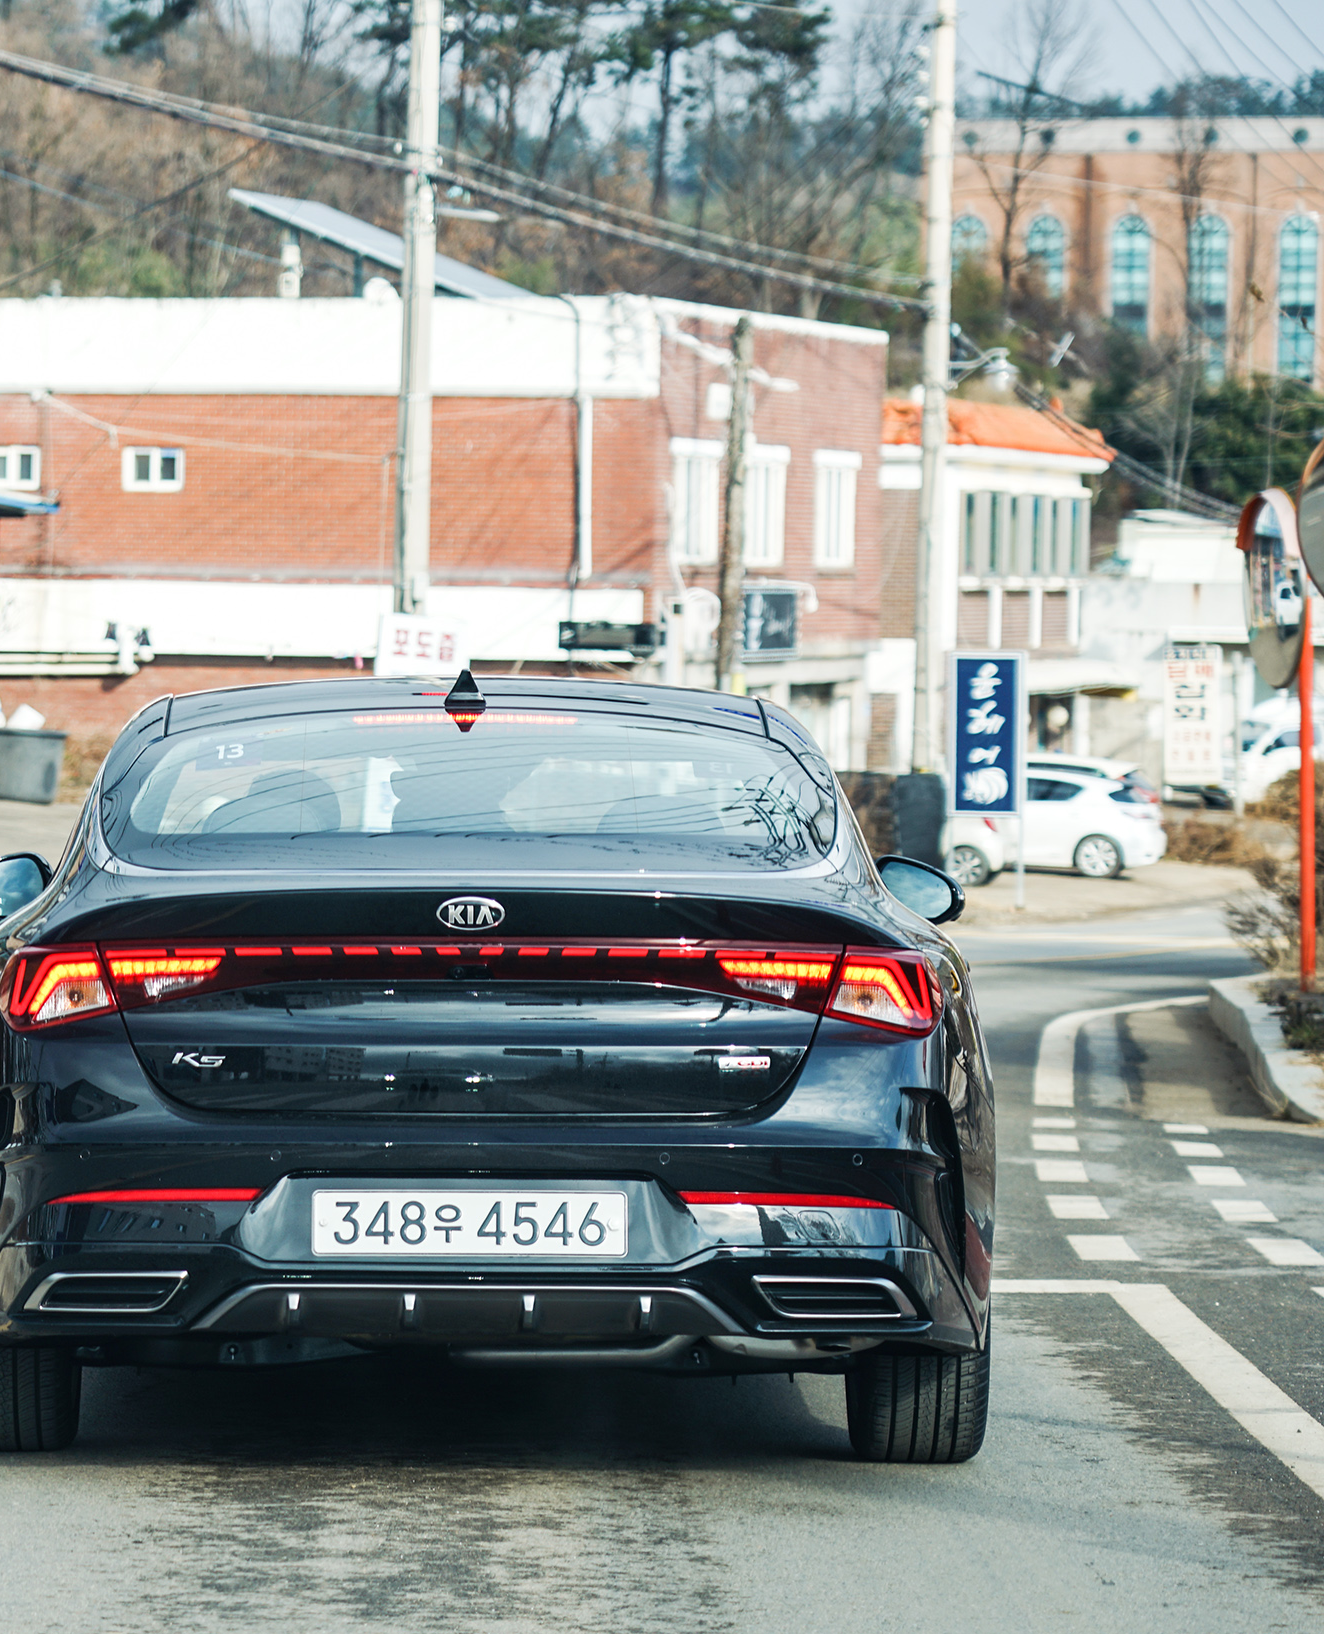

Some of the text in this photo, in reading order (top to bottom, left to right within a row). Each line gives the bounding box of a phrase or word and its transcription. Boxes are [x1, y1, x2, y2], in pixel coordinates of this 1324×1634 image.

[393, 629, 455, 662] 포도즙
[216, 743, 245, 760] 13
[447, 904, 495, 925] KIA
[172, 1052, 226, 1067] K5
[333, 1201, 608, 1247] 348우 4546
